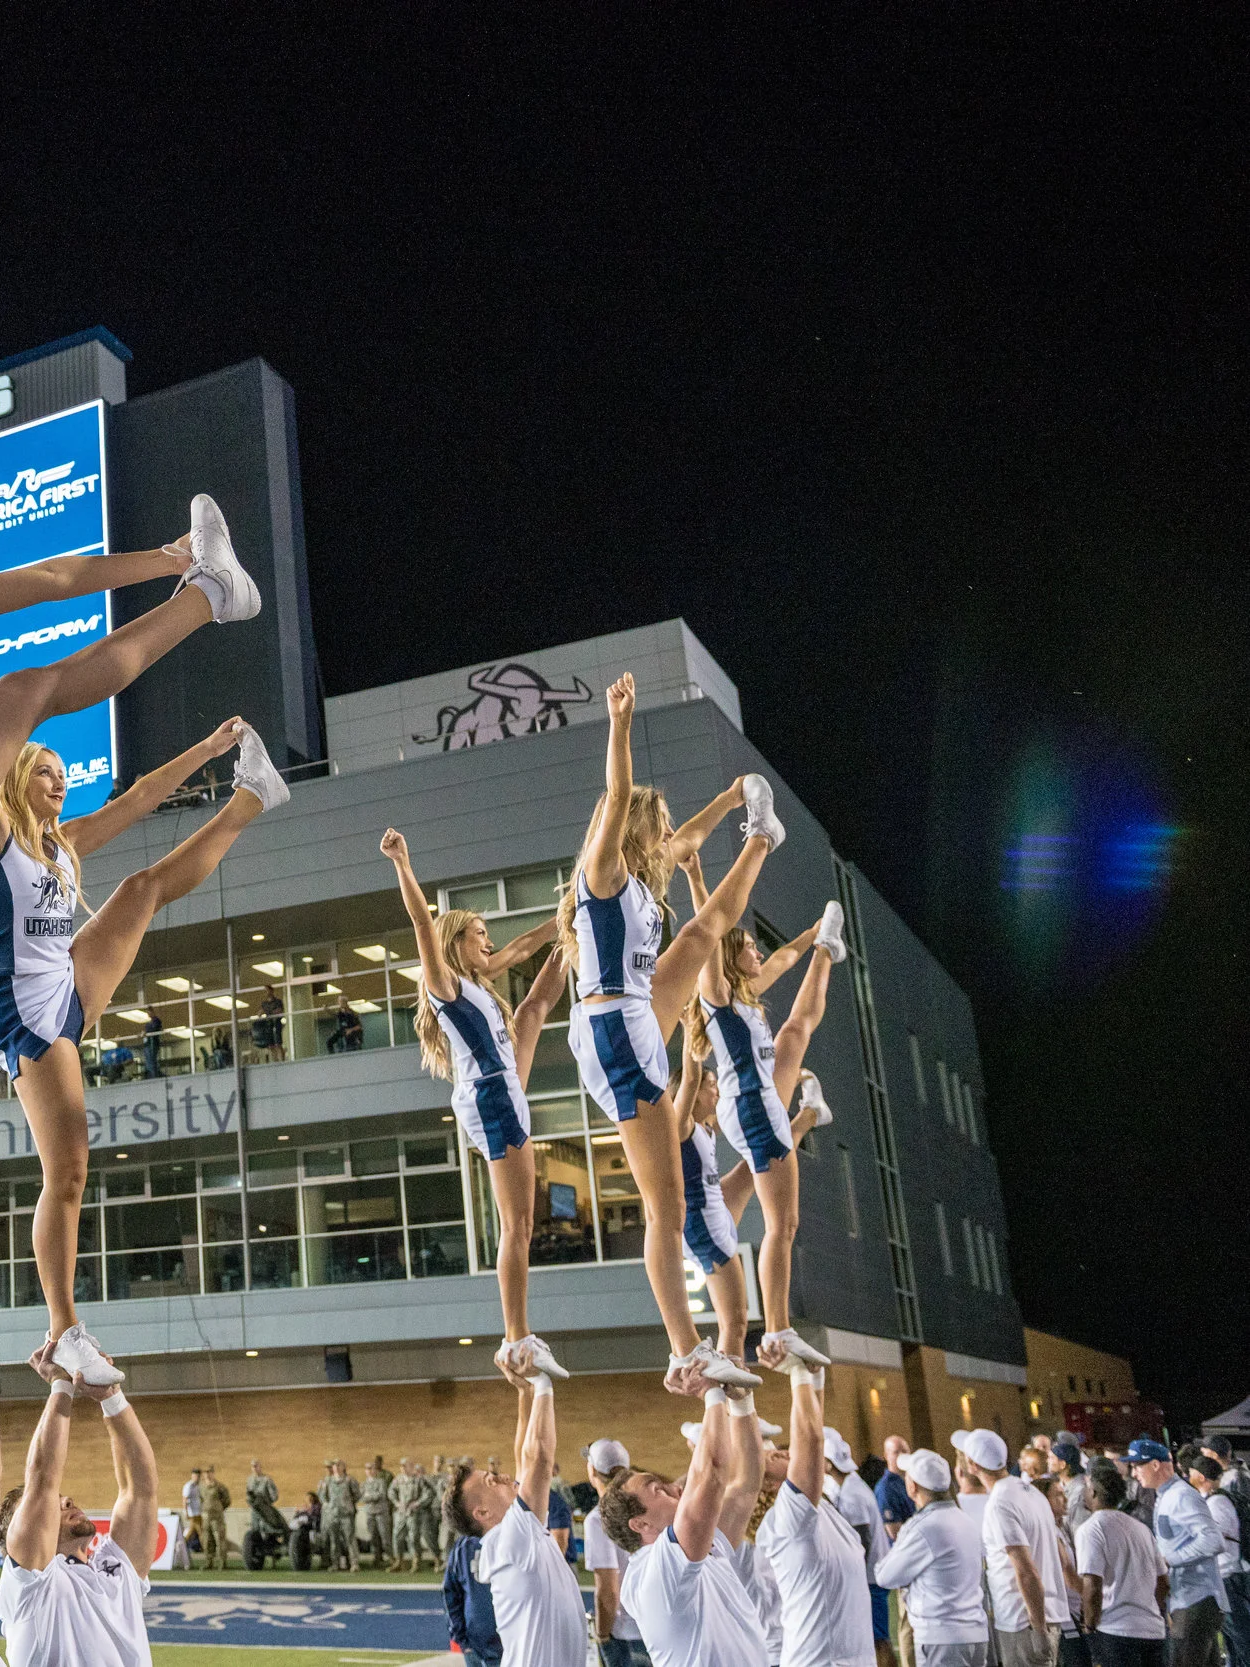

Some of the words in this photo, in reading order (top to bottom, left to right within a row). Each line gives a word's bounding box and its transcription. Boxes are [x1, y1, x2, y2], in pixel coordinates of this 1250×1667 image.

[39, 474, 100, 508] FIRST
[28, 504, 65, 522] UNION
[24, 916, 59, 937] UTAH
